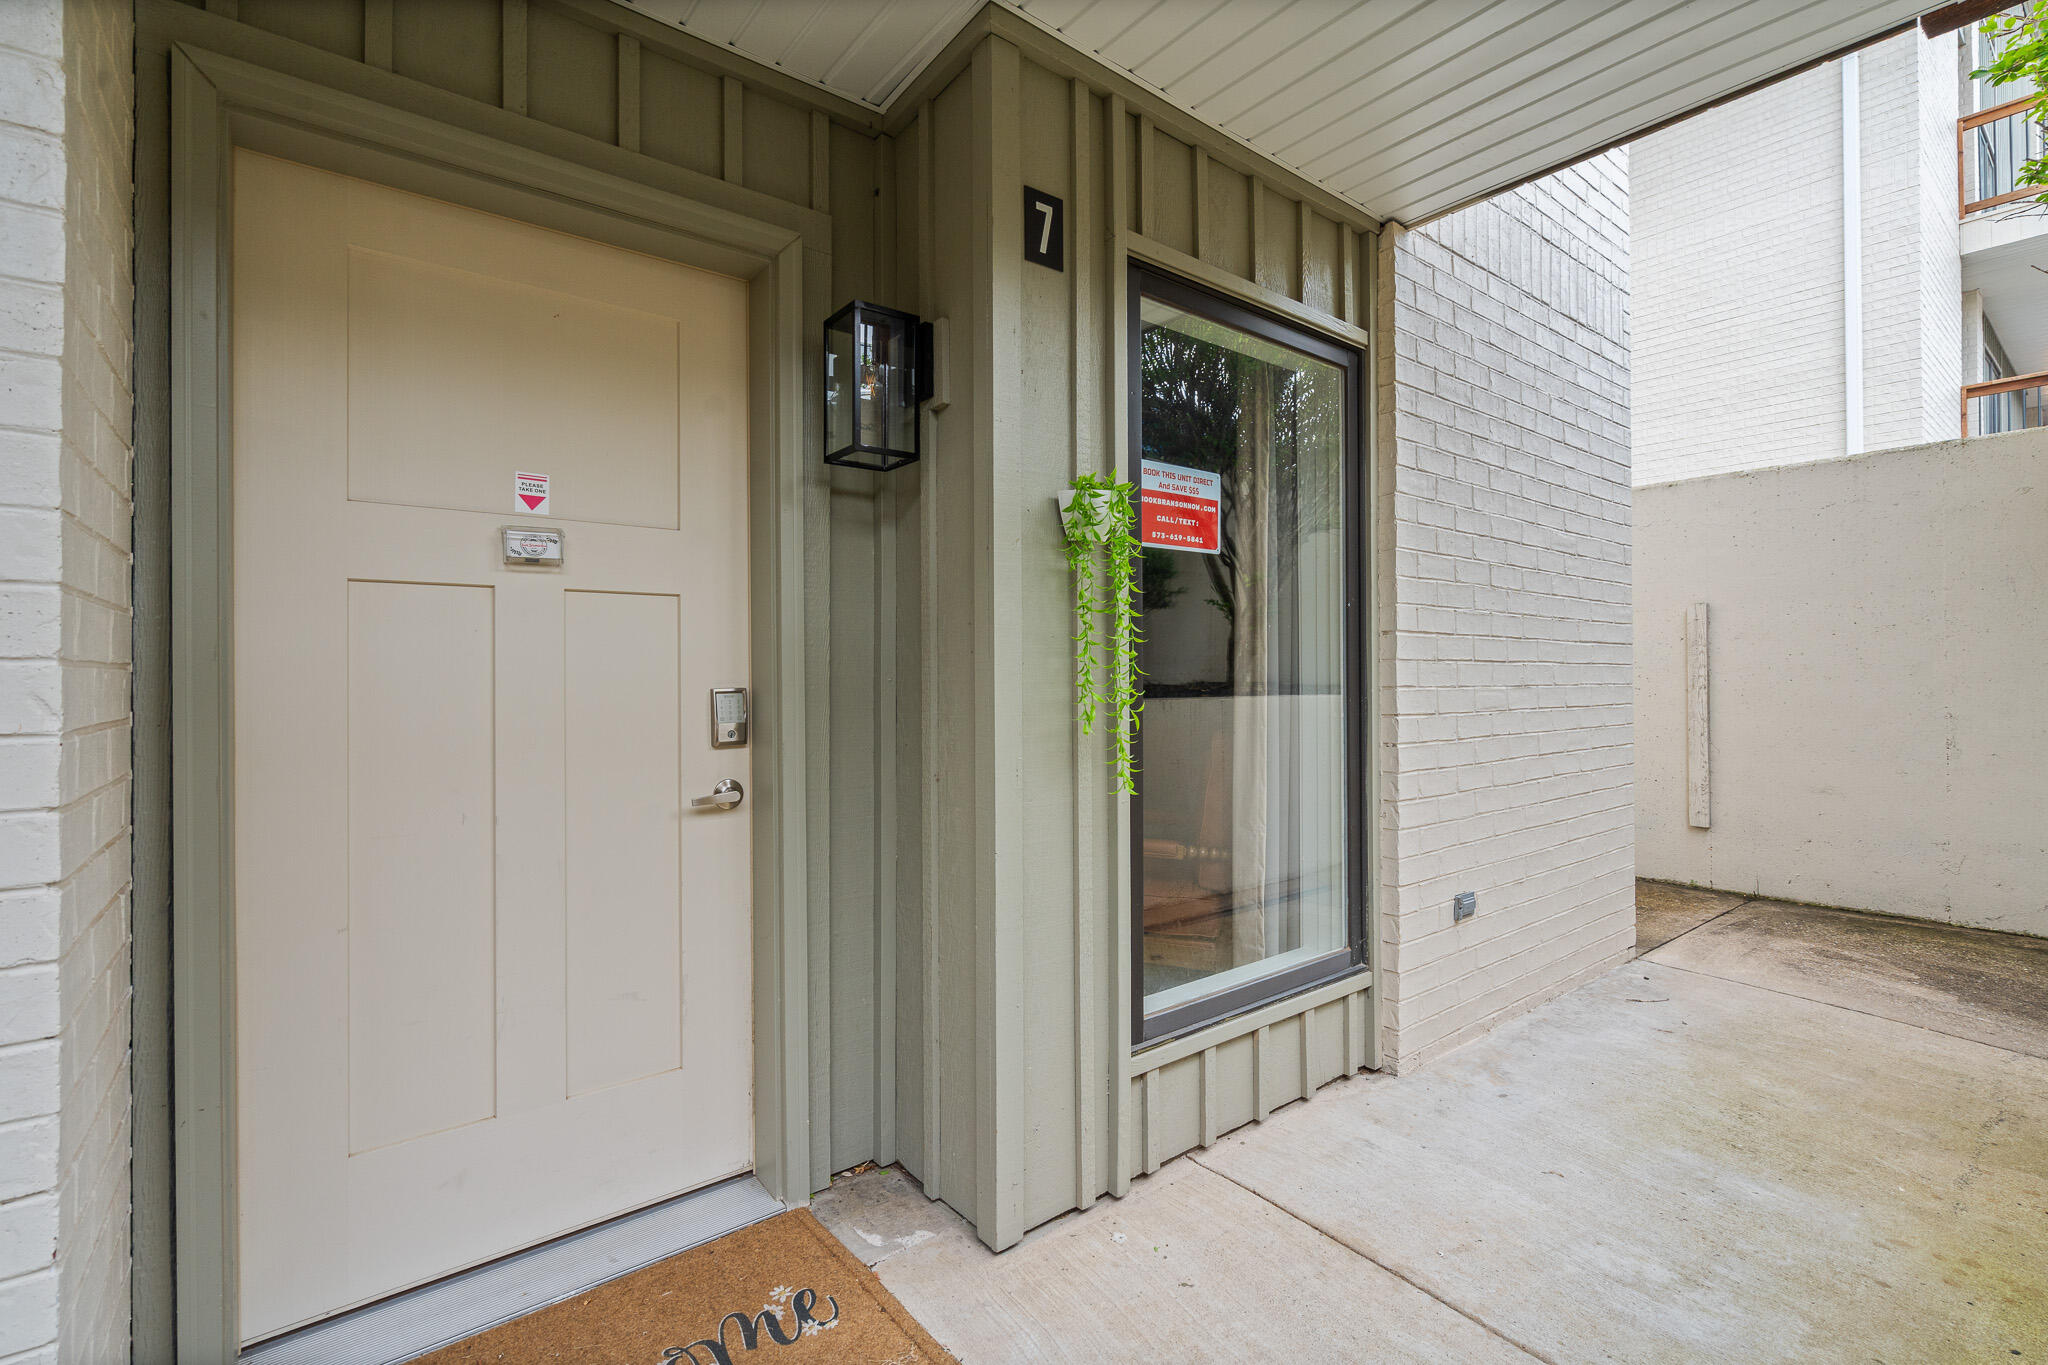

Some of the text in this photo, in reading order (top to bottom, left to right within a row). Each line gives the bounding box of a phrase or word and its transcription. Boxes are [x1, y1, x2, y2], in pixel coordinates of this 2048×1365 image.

[1035, 201, 1053, 254] 7
[1143, 467, 1213, 486] BOOK THIS UNIT DIRECT
[1158, 481, 1170, 490] And
[1171, 483, 1188, 493] SAVE
[1156, 514, 1199, 527] CALL/TEXT:
[1152, 531, 1204, 544] 573-619-5841
